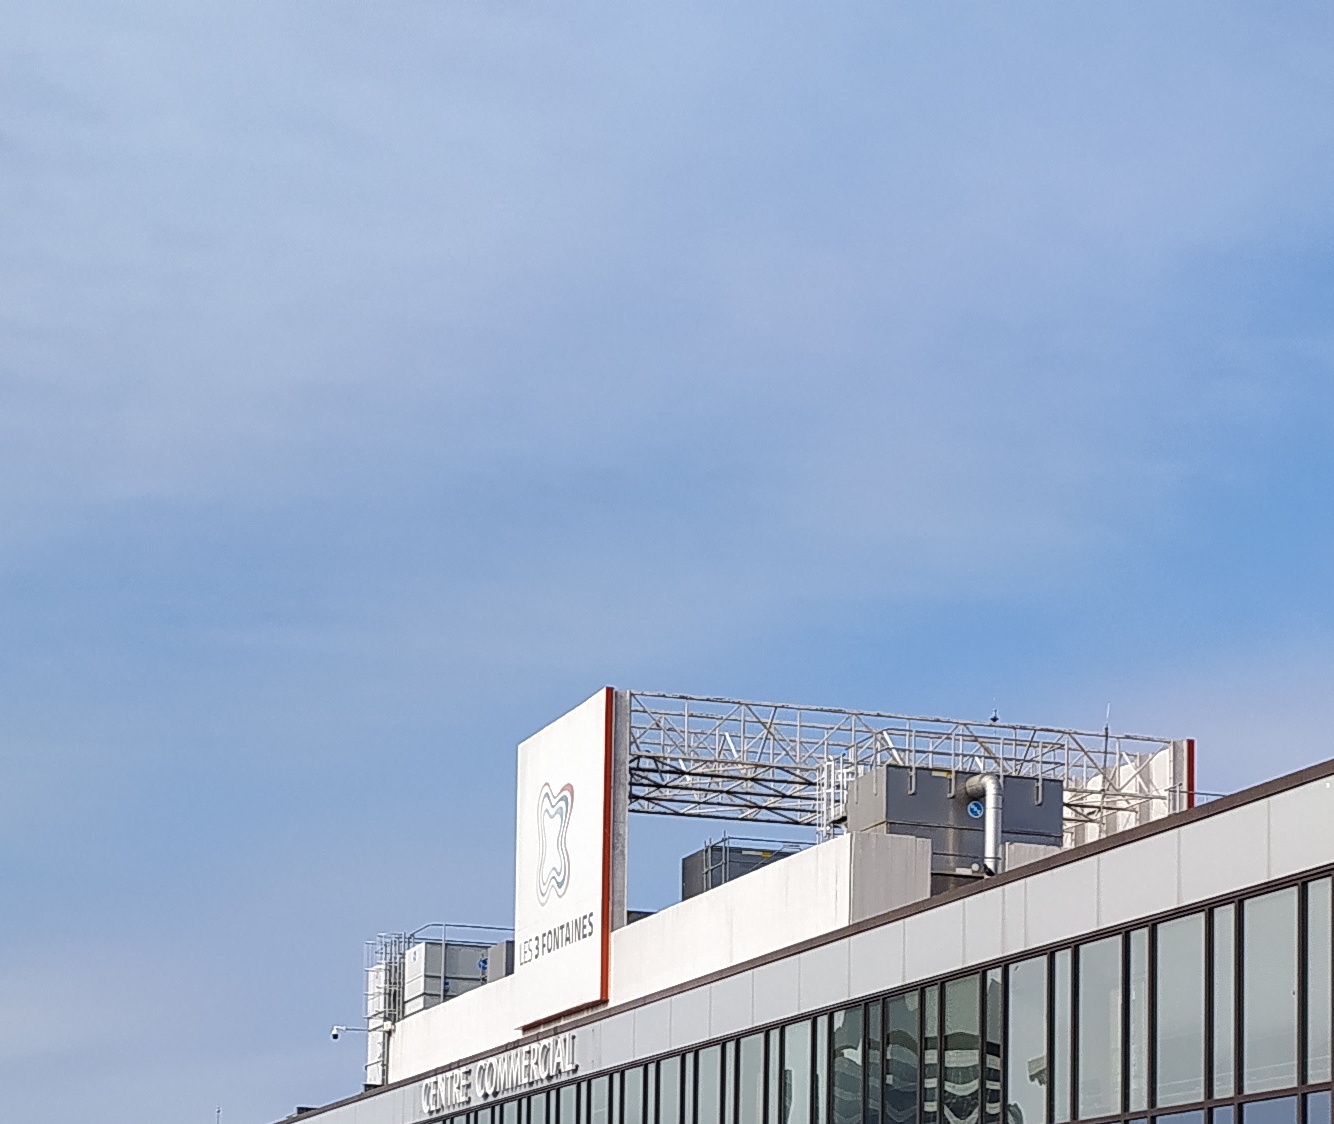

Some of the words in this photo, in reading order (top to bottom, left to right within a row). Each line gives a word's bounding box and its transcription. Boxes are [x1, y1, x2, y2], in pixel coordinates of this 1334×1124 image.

[519, 938, 533, 966] LES
[534, 935, 540, 960] 3
[541, 911, 594, 956] FONTAINES
[421, 1067, 470, 1114] CENTRE
[475, 1033, 574, 1098] COMMERCIAL
